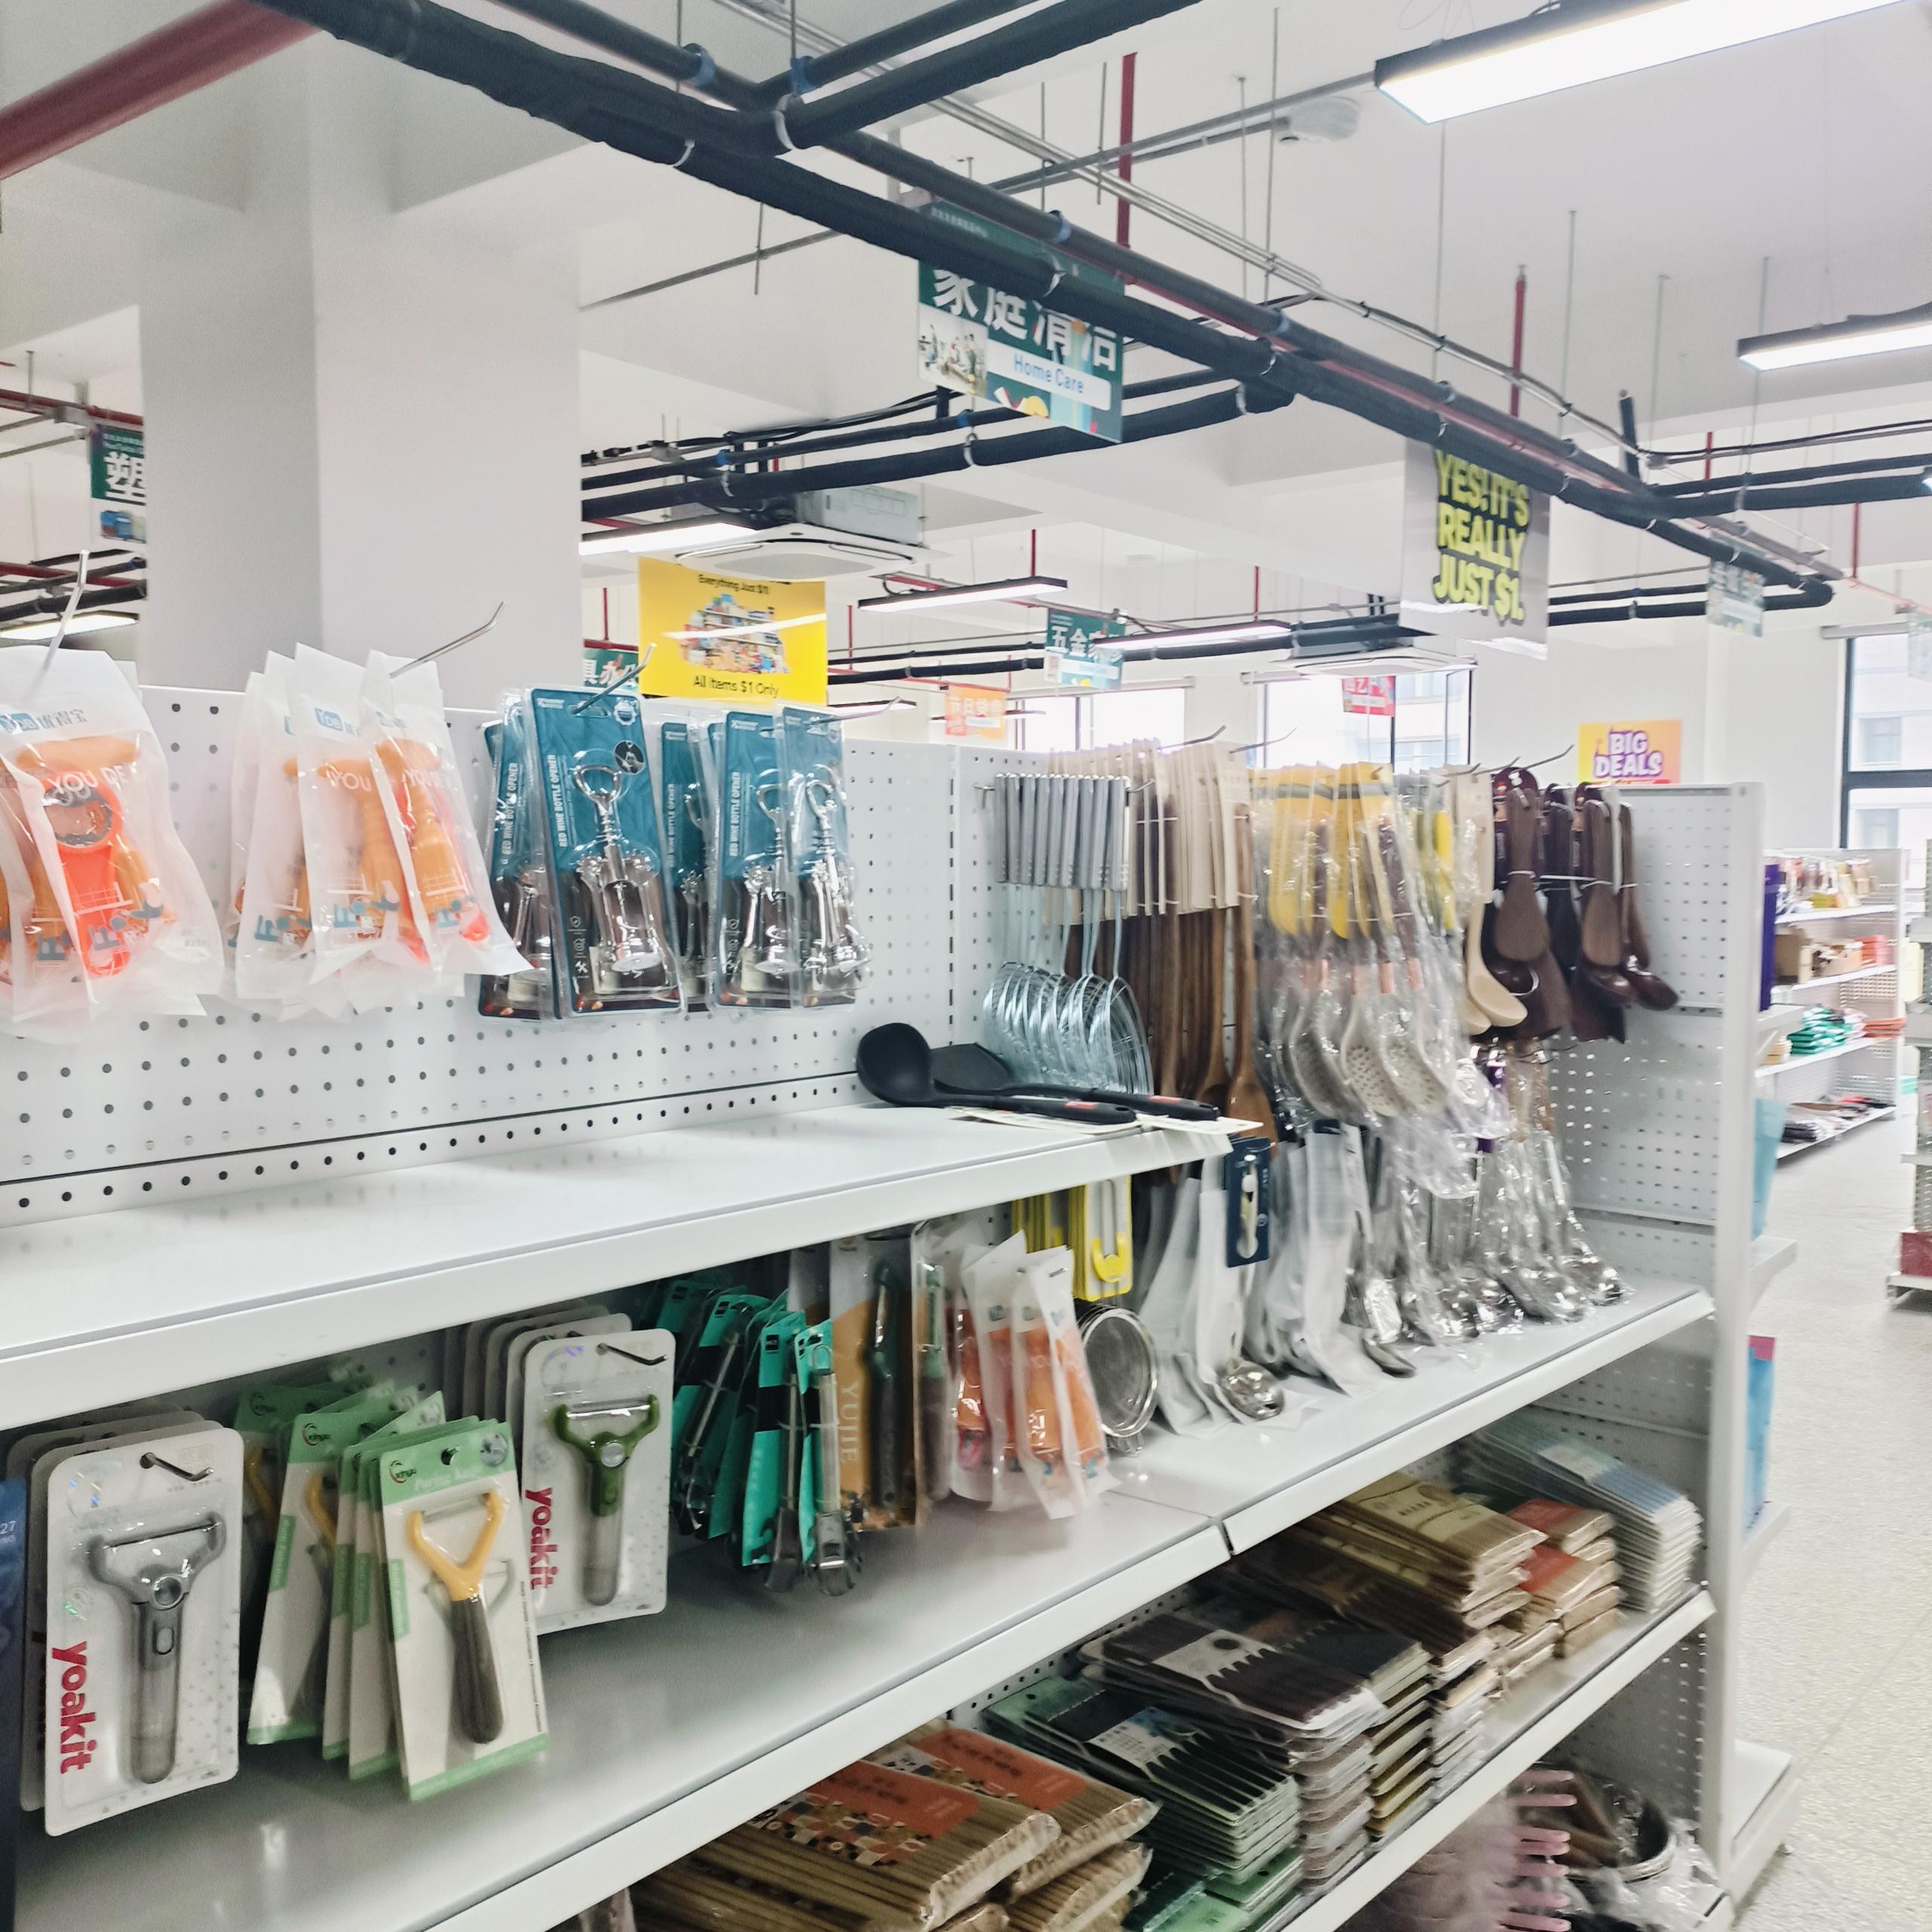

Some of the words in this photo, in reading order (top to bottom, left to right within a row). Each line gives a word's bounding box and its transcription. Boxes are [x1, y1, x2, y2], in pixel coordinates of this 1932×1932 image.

[1014, 352, 1051, 383] Home
[1055, 368, 1084, 394] Care
[1437, 501, 1526, 571] REALLY
[1432, 553, 1495, 611] JUST
[1045, 626, 1124, 664] 五金
[693, 675, 706, 688] All
[710, 676, 737, 692] Items
[740, 680, 753, 693] $1
[755, 681, 779, 699] Only
[1608, 731, 1648, 755] BIG
[506, 762, 518, 791] OPENER
[546, 754, 560, 783] OPENER
[1594, 750, 1663, 778] DEALS
[47, 769, 99, 795] YOU
[328, 771, 372, 792] YOU
[731, 771, 741, 798] OPENER
[551, 784, 564, 811] BOTTLE
[667, 783, 675, 810] OPENER
[555, 812, 567, 832] WINE
[731, 799, 740, 825] BOTTLE
[503, 820, 514, 839] WINE
[558, 832, 568, 848] RED
[730, 825, 740, 842] WINE
[501, 840, 512, 855] RED
[729, 843, 739, 857] RED
[525, 1487, 558, 1590] yoakit
[51, 1641, 97, 1775] yoakit
